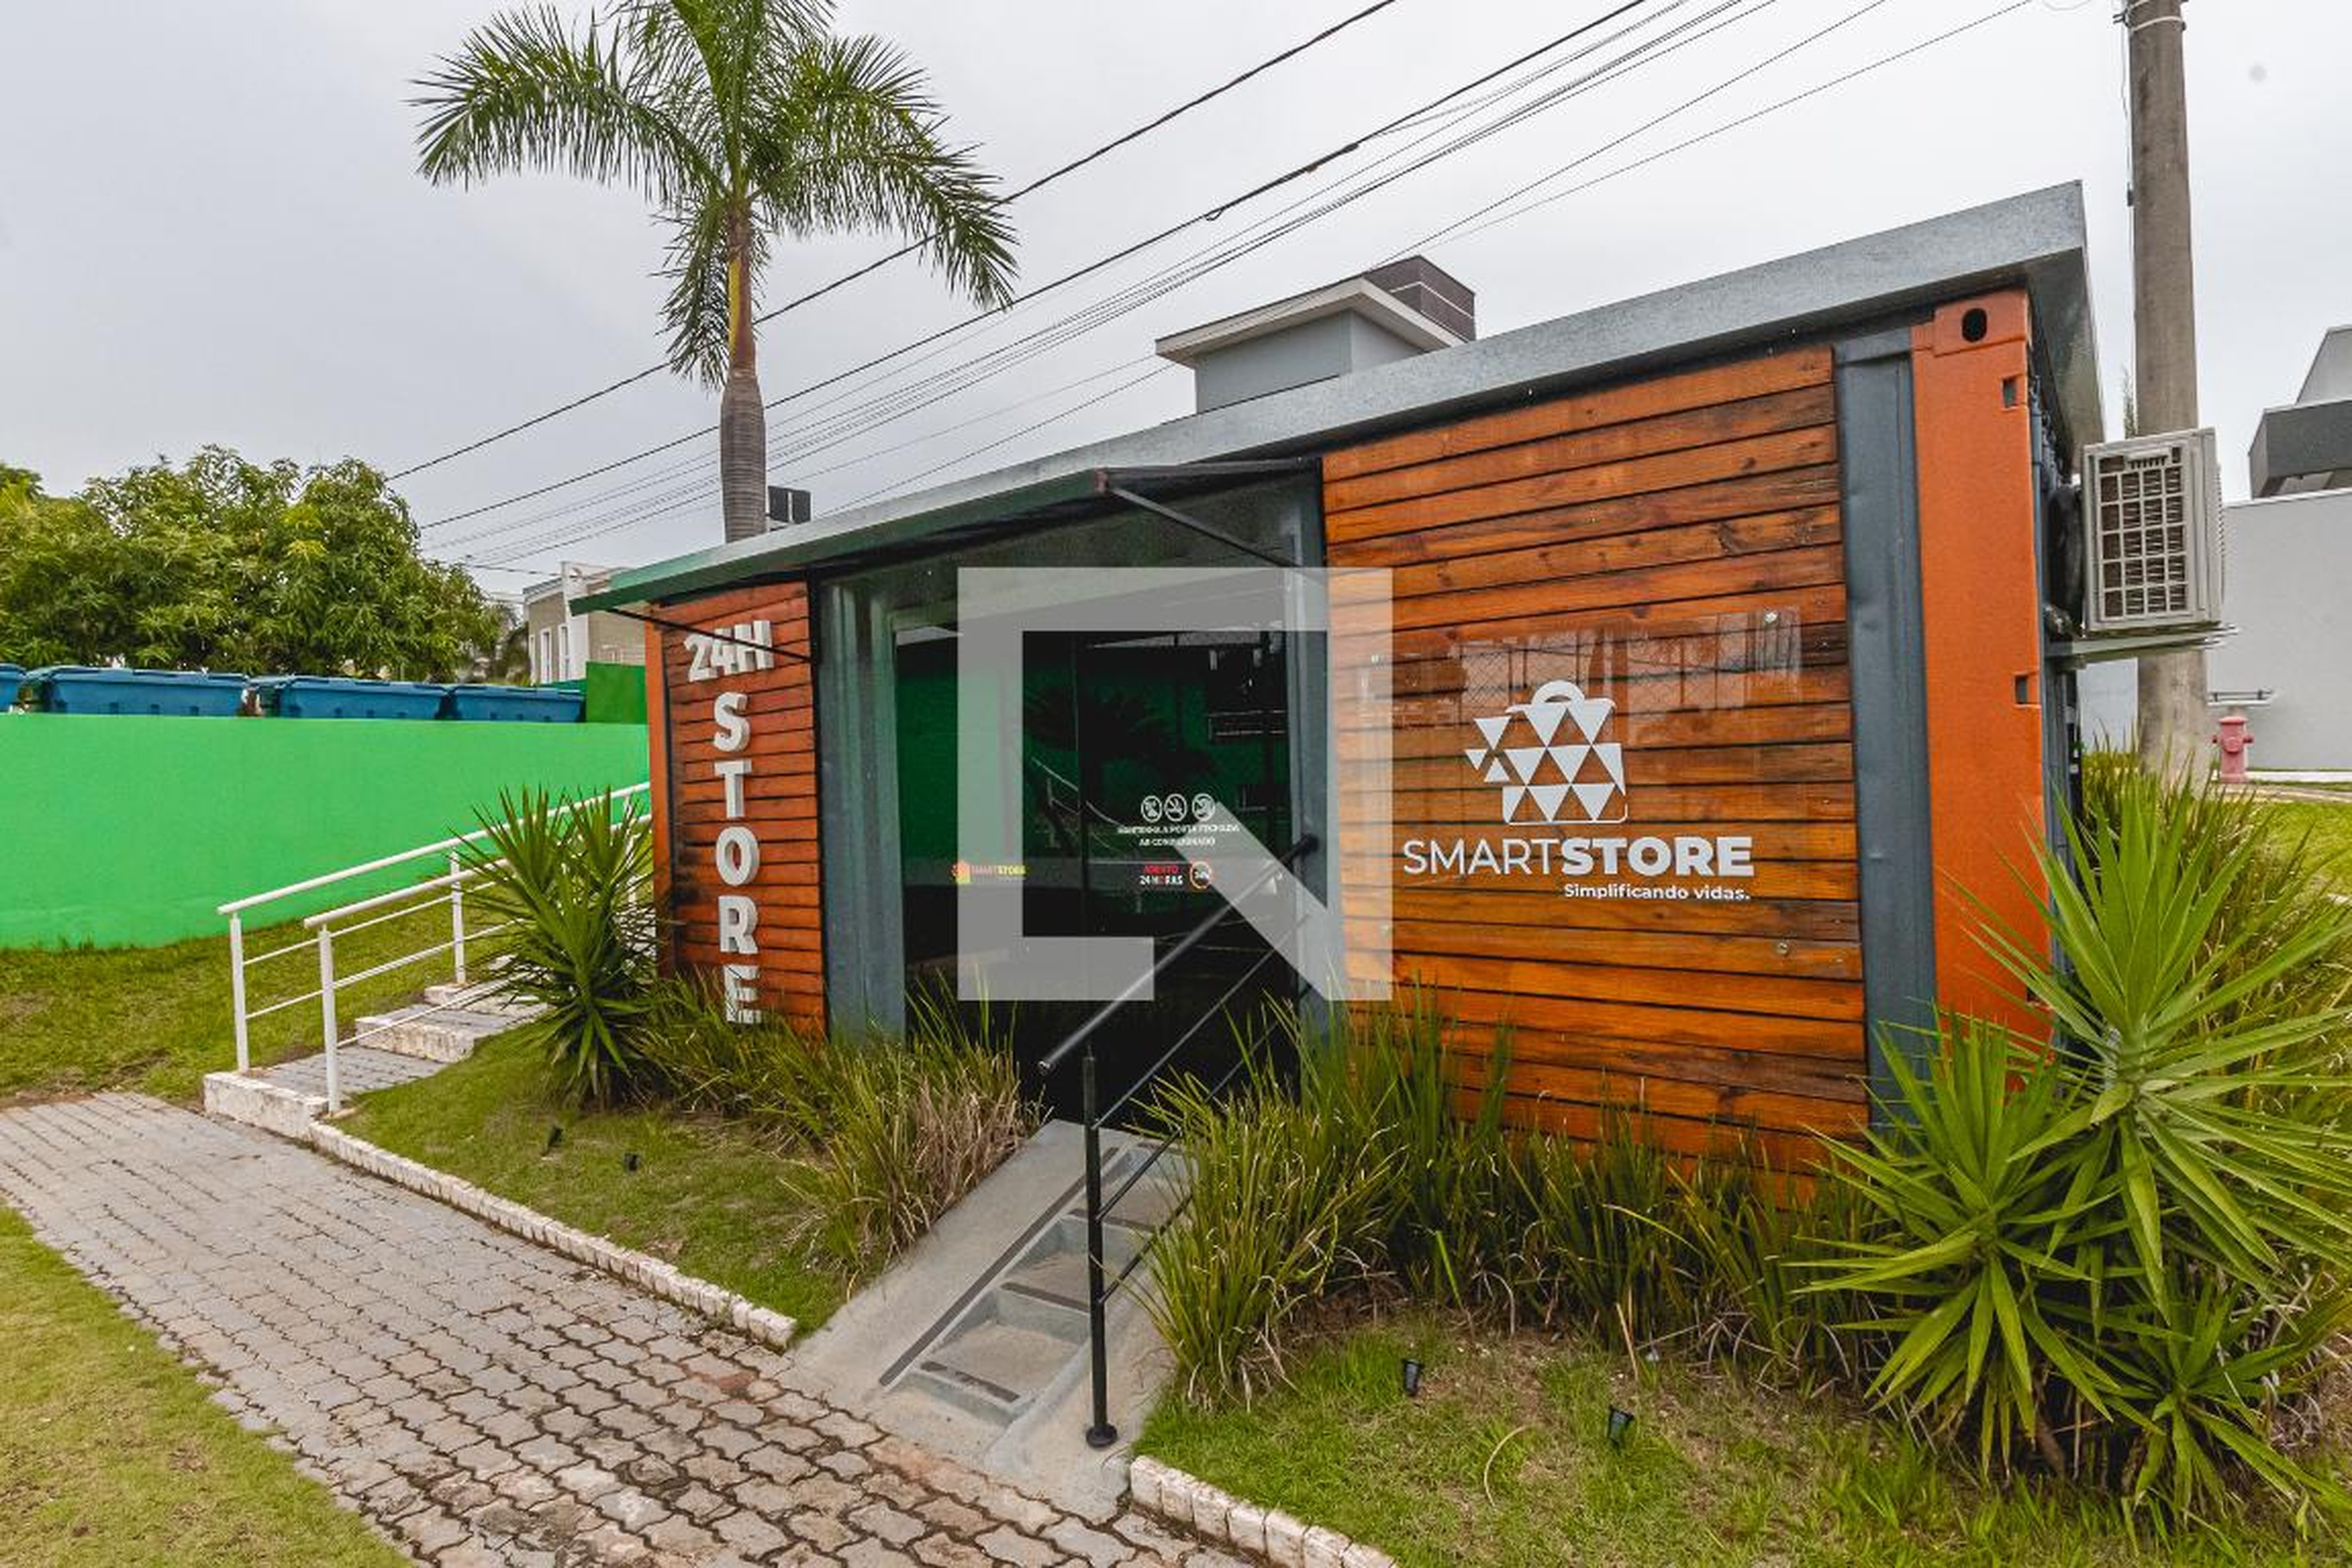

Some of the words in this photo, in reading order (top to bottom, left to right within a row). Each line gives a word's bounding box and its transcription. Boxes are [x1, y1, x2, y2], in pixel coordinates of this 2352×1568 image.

[684, 620, 774, 682] 24H
[713, 691, 762, 1024] STORE
[1403, 837, 1754, 876] SMARTSTORE
[1564, 883, 1689, 899] Simplificando
[1694, 884, 1751, 900] vidas.
